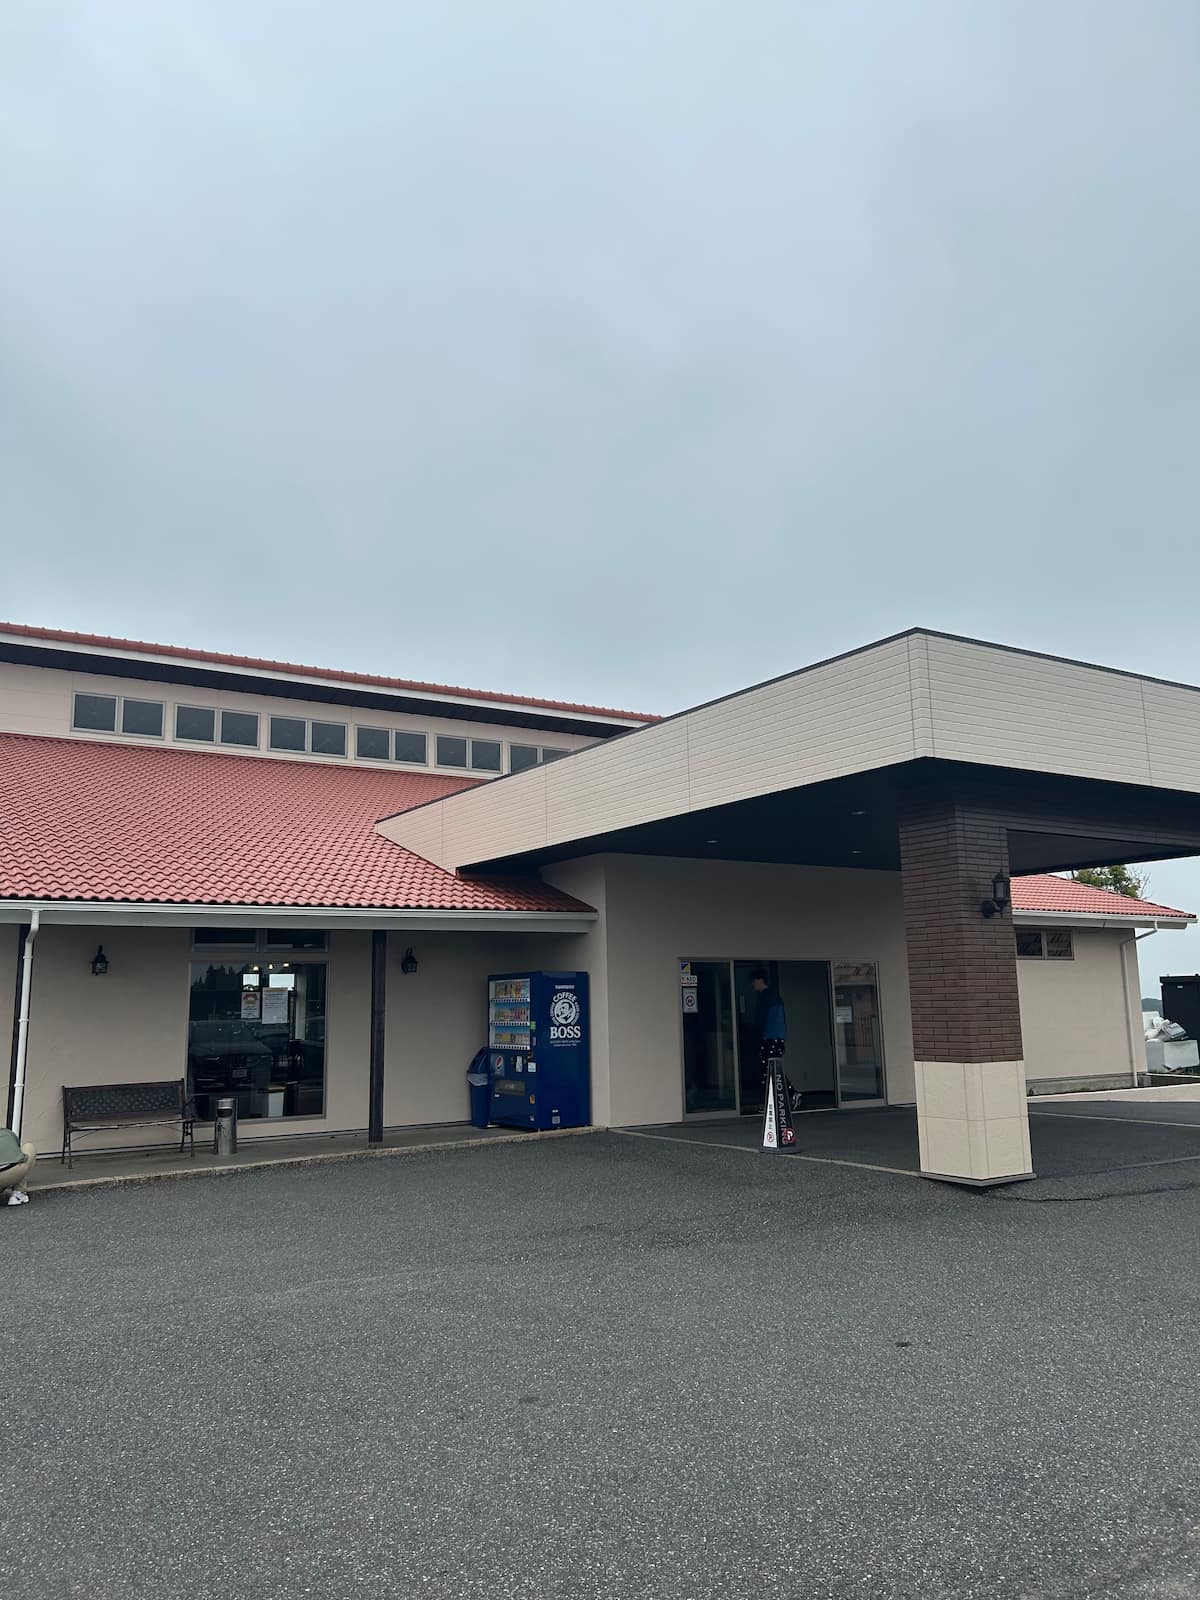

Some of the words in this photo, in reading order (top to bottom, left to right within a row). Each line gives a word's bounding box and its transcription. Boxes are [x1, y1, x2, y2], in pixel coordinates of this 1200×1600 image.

[553, 992, 577, 1002] COFFEE
[550, 1026, 581, 1039] BOSS
[776, 1074, 783, 1091] NO
[778, 1094, 789, 1145] PARKING
